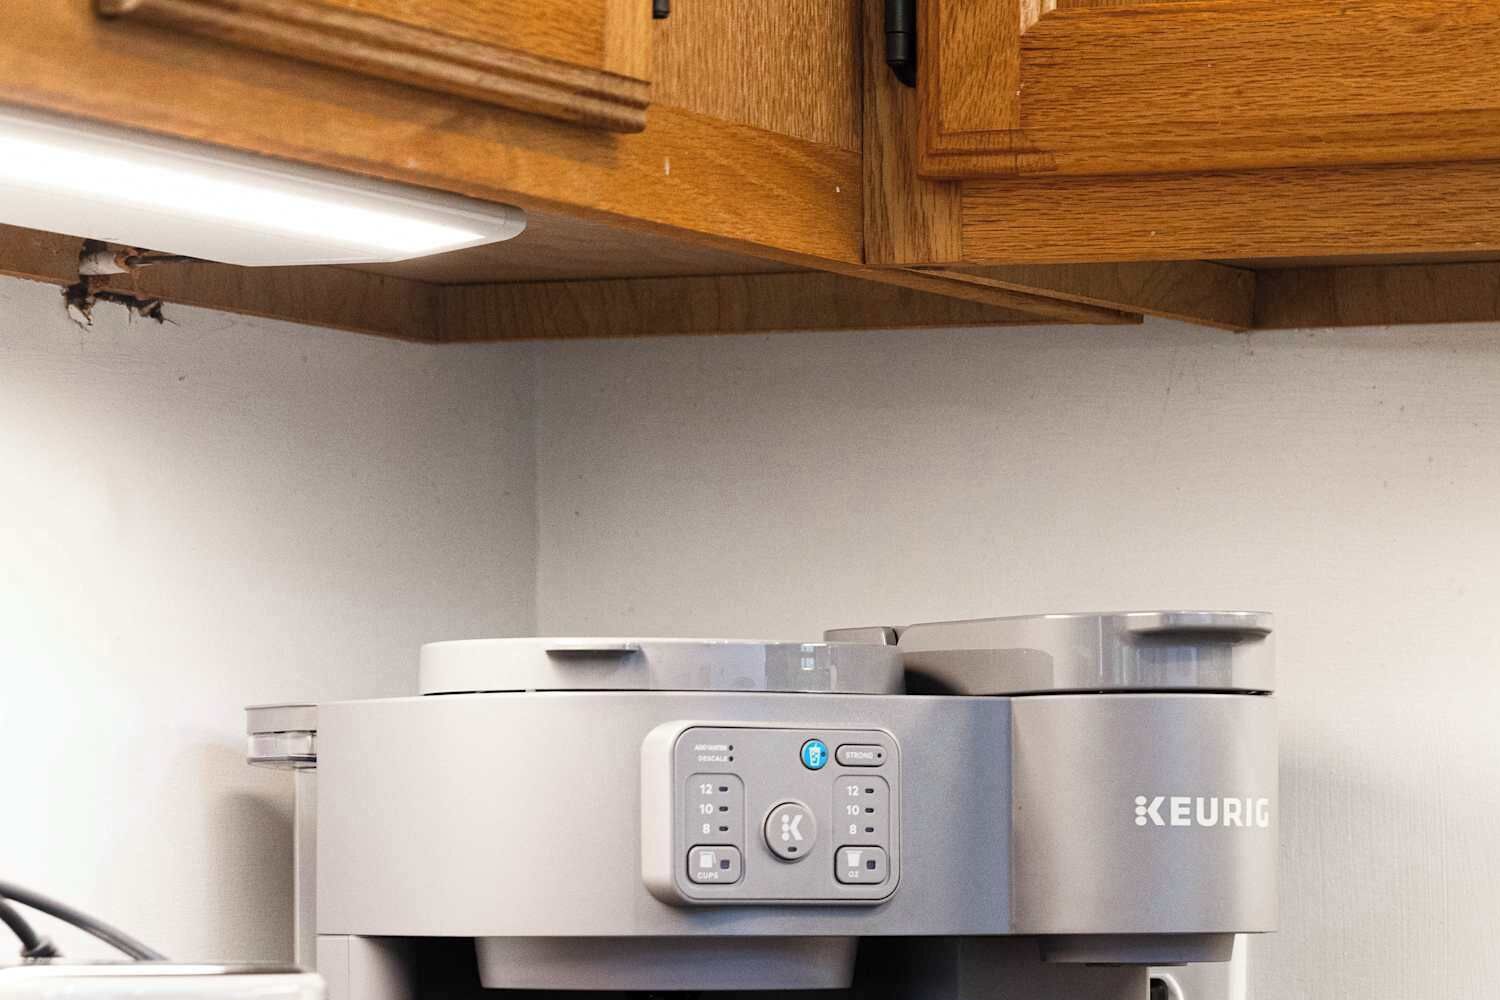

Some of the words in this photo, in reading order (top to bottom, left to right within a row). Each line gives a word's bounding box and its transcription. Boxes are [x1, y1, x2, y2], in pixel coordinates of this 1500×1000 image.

[699, 784, 713, 794] 12
[847, 785, 860, 796] 12
[699, 804, 713, 815] 10
[847, 805, 860, 815] 10
[1135, 796, 1269, 827] KEURIG
[702, 824, 711, 834] 8
[849, 824, 858, 835] 8
